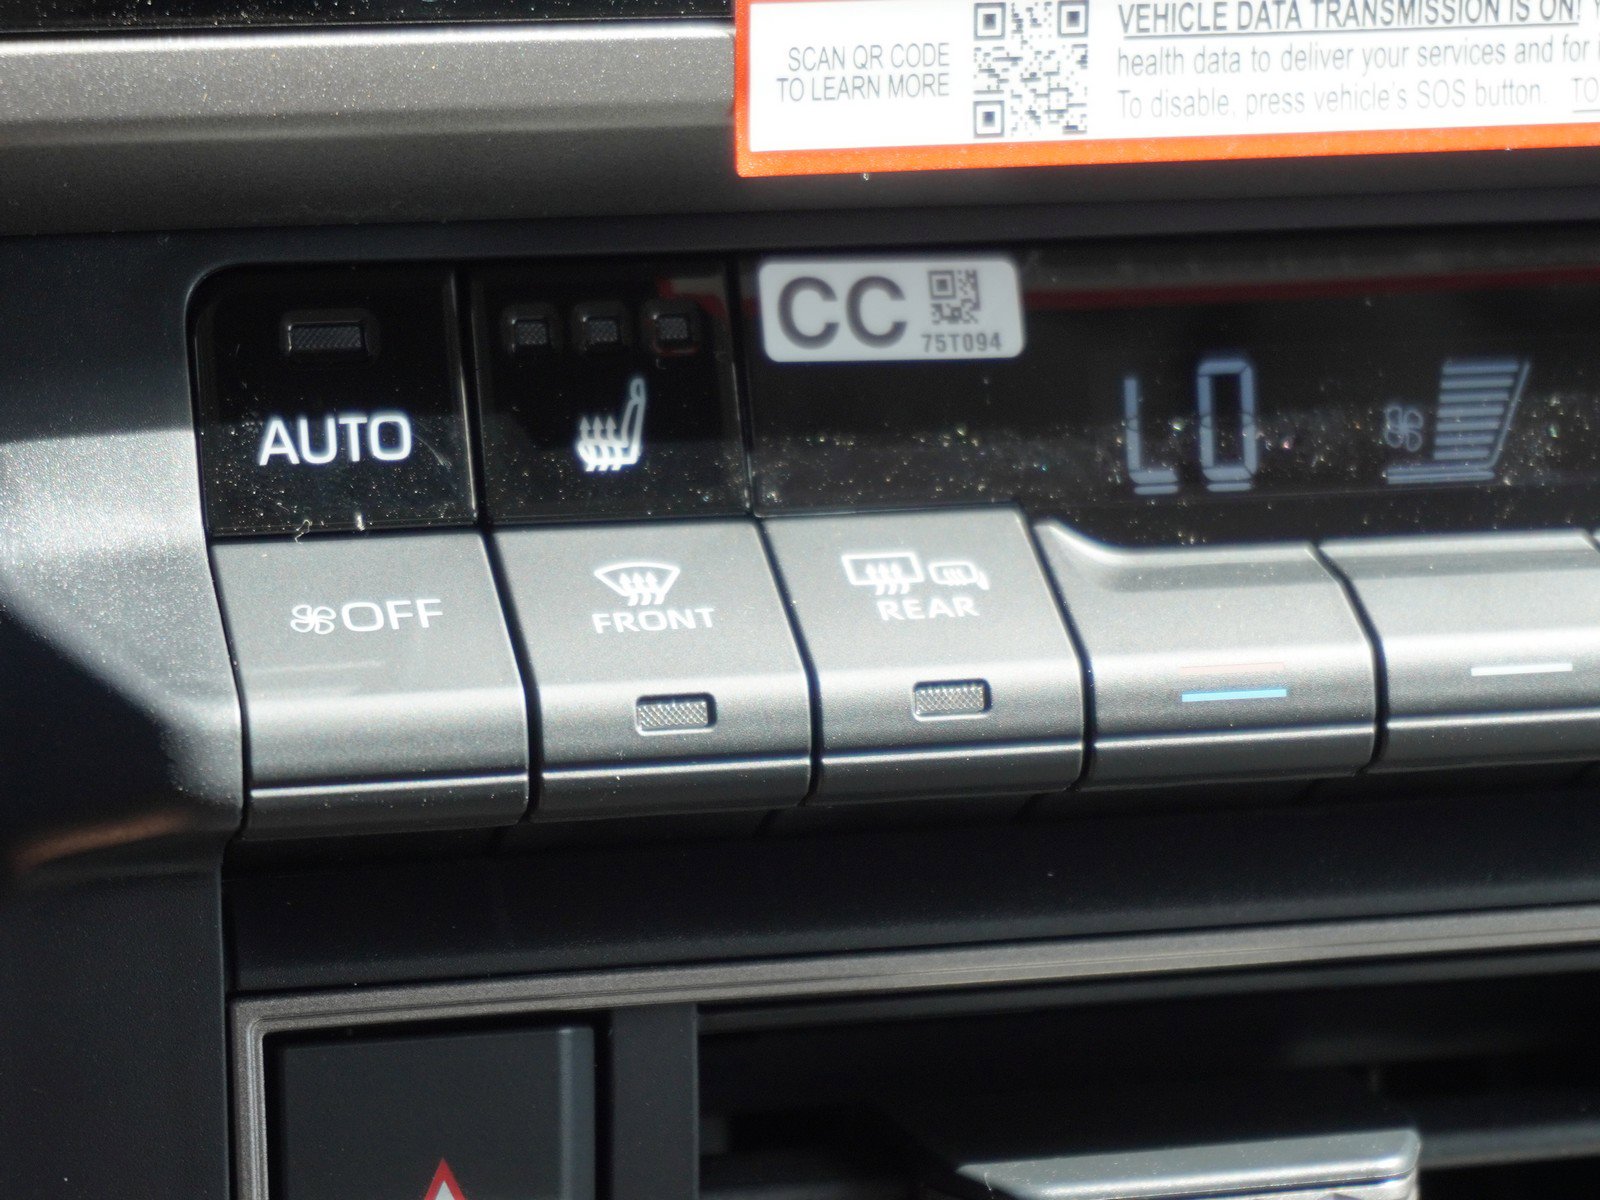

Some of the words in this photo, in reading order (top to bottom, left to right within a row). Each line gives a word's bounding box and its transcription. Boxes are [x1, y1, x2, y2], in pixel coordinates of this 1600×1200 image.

[1117, 1, 1228, 34] VEHICLE
[1236, 0, 1302, 31] DATA
[1310, 0, 1500, 28] TRANSMISSION
[1509, 0, 1531, 22] IS
[787, 46, 846, 73] SCAN
[852, 44, 884, 70] QR
[890, 42, 950, 69] CODE
[1117, 46, 1185, 77] health
[1193, 45, 1241, 75] data
[1251, 45, 1272, 73] to
[1280, 41, 1354, 73] deliver
[1361, 46, 1410, 78] your
[1416, 36, 1506, 68] services
[1514, 35, 1554, 64] and
[1562, 33, 1591, 62] for
[776, 76, 805, 103] TO
[811, 74, 881, 102] LEARN
[888, 71, 950, 98] MORE
[1117, 88, 1143, 120] To
[1246, 90, 1306, 122] press
[1314, 81, 1408, 113] vehicle's
[1416, 78, 1466, 109] SOS
[777, 274, 909, 351] CC
[920, 331, 1003, 354] 75T094
[257, 411, 413, 468] AUTO
[340, 597, 444, 634] OFF
[591, 605, 716, 636] FRONT
[876, 596, 981, 622] REAR
